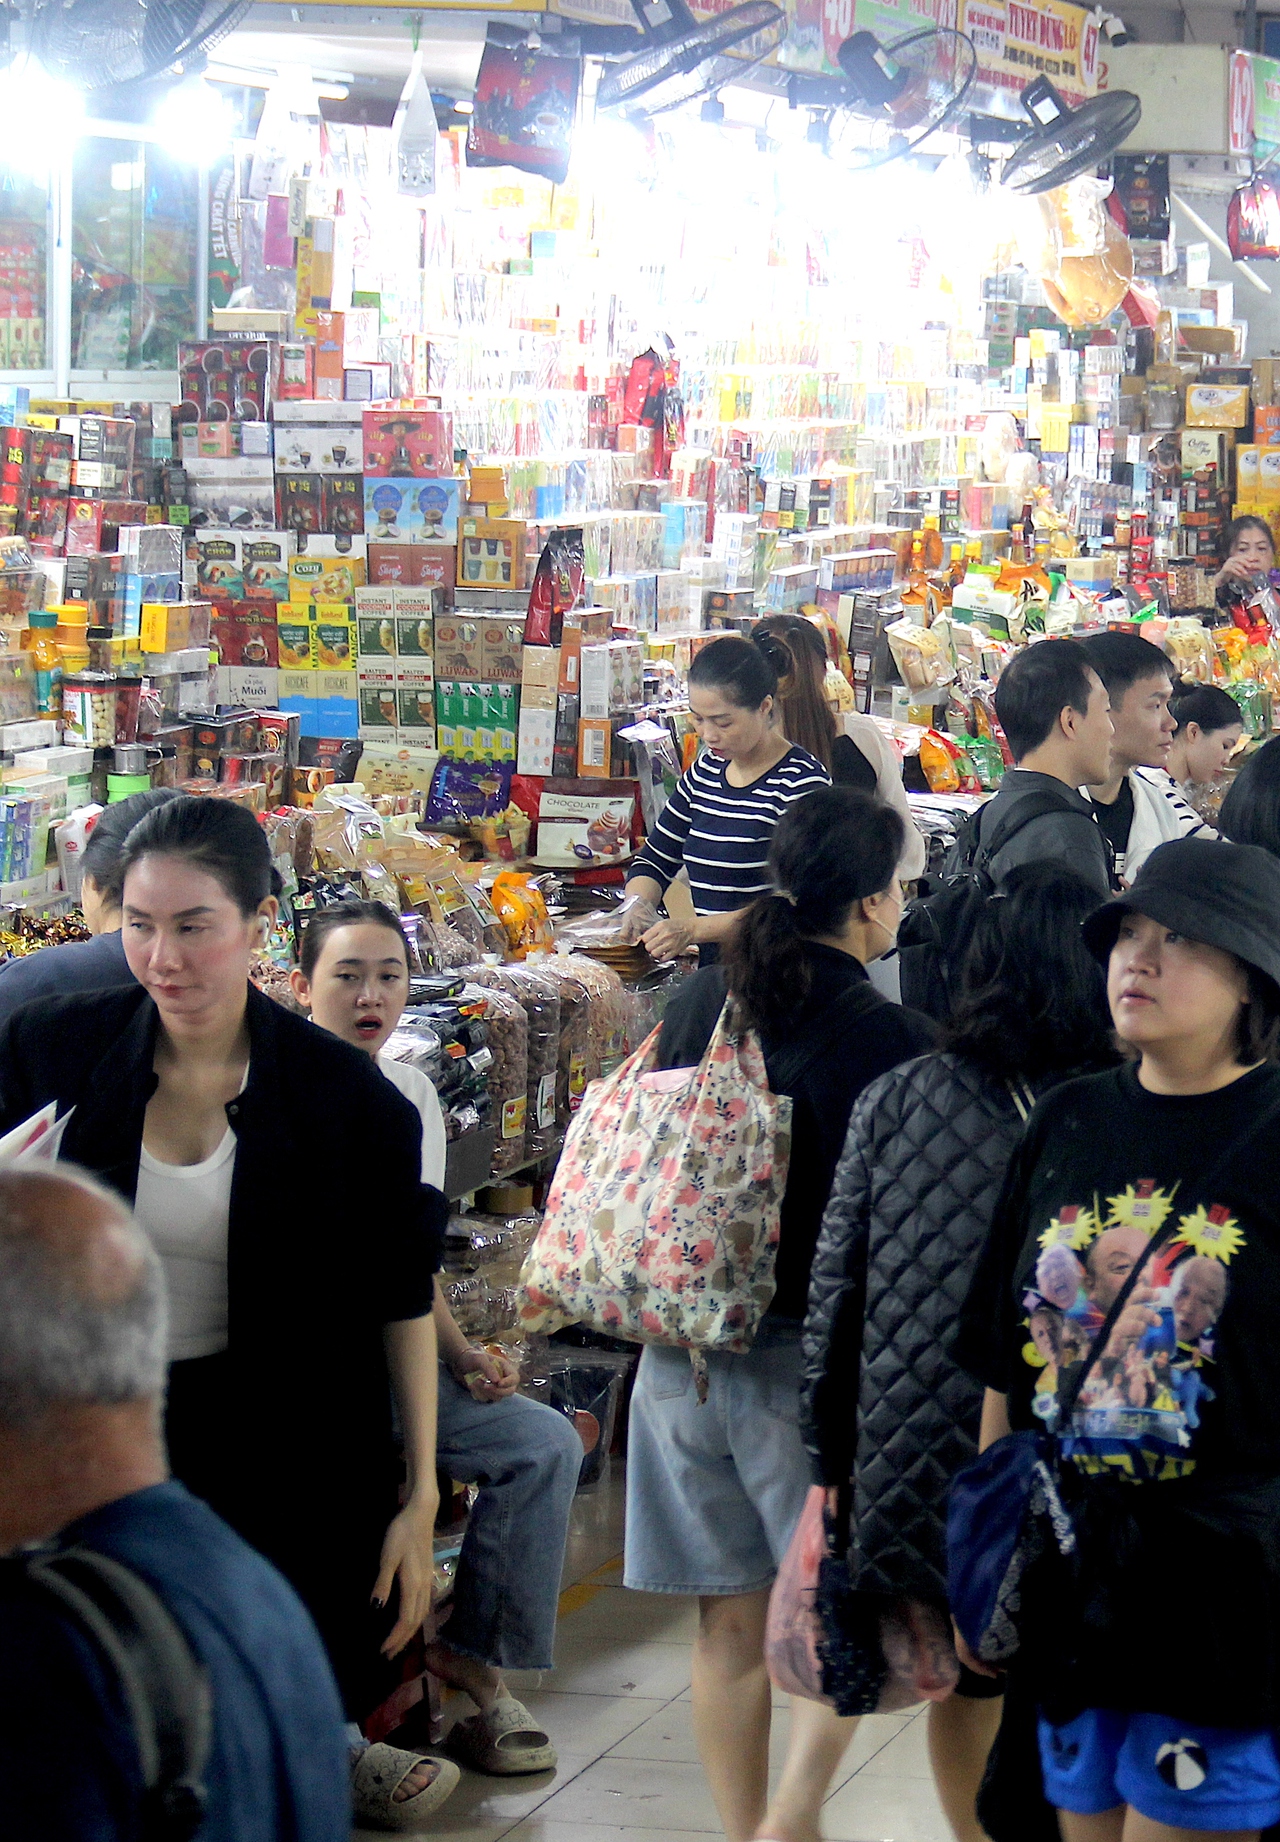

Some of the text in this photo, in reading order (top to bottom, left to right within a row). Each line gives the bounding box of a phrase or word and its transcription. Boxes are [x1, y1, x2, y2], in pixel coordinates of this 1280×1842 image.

[1188, 438, 1209, 448] Coffee
[296, 563, 321, 573] Cozy
[546, 798, 601, 810] CHOCOLATE
